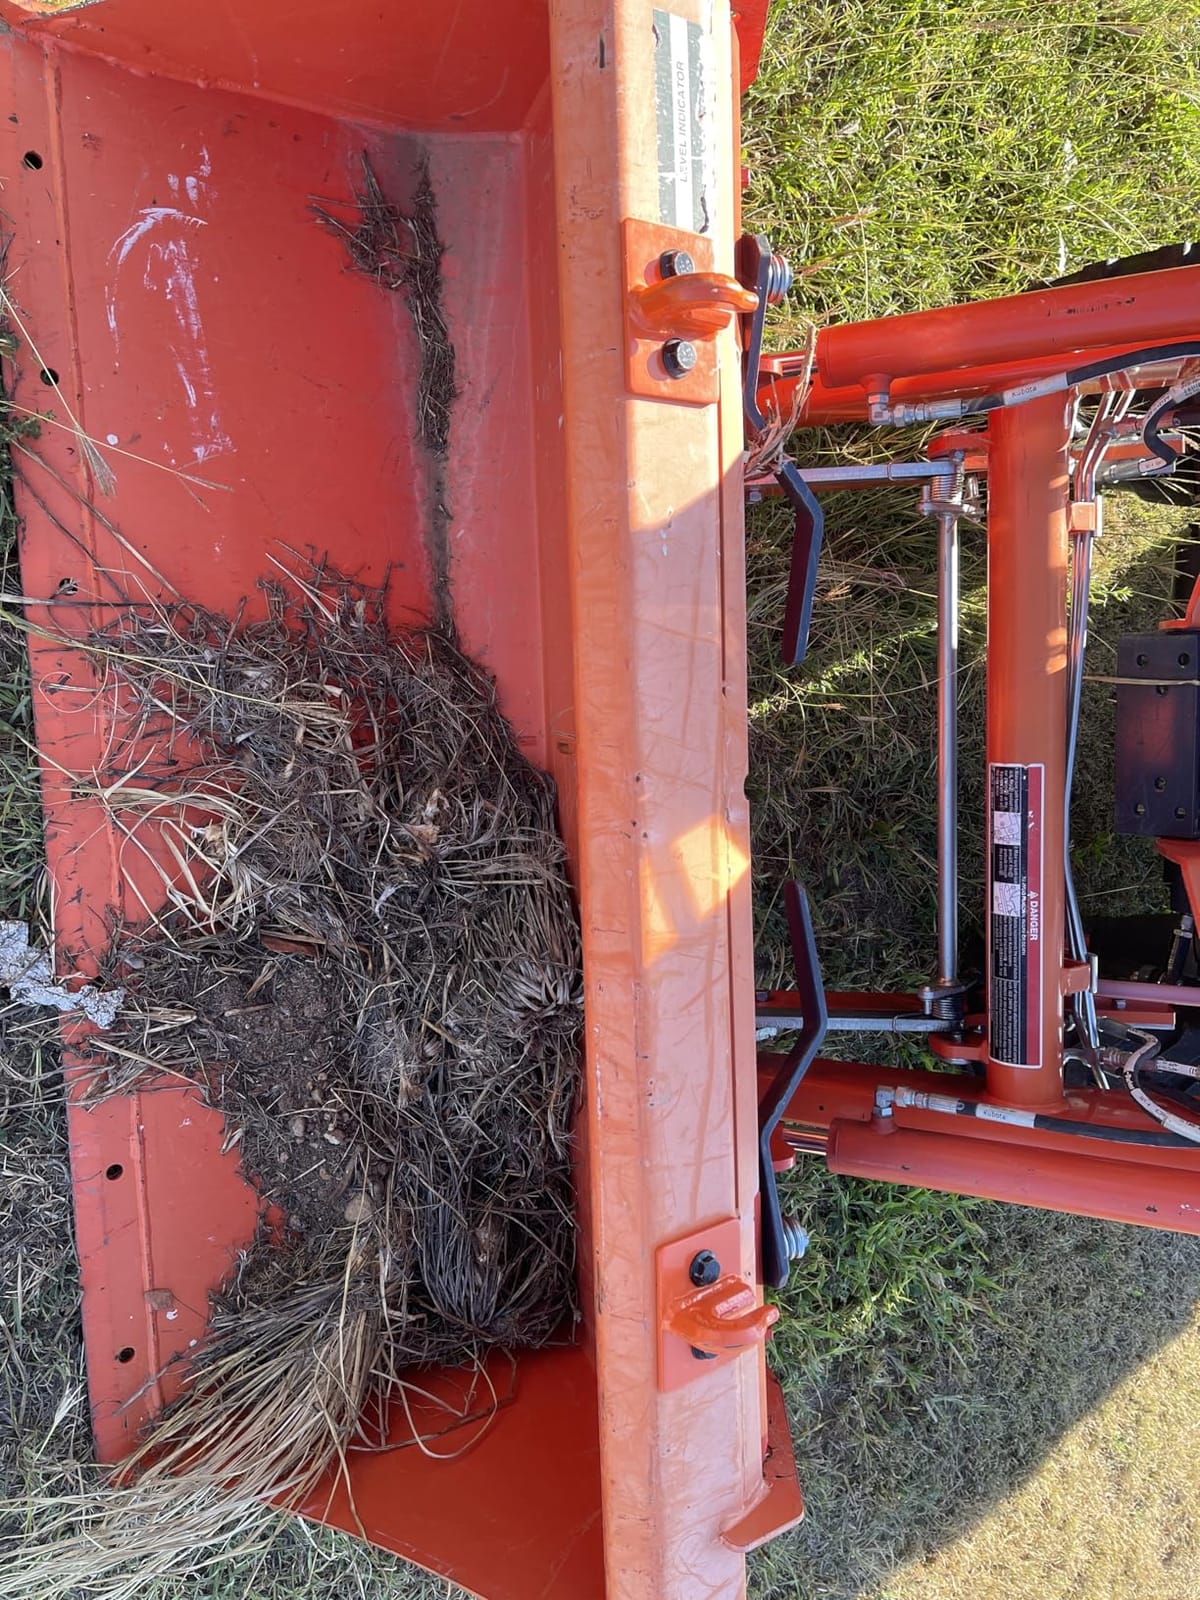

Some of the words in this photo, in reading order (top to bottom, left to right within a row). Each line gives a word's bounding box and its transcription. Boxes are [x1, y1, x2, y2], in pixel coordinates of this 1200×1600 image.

[676, 61, 686, 136] INDICATOR
[679, 140, 688, 183] LEVEL
[1030, 900, 1039, 941] DANGER
